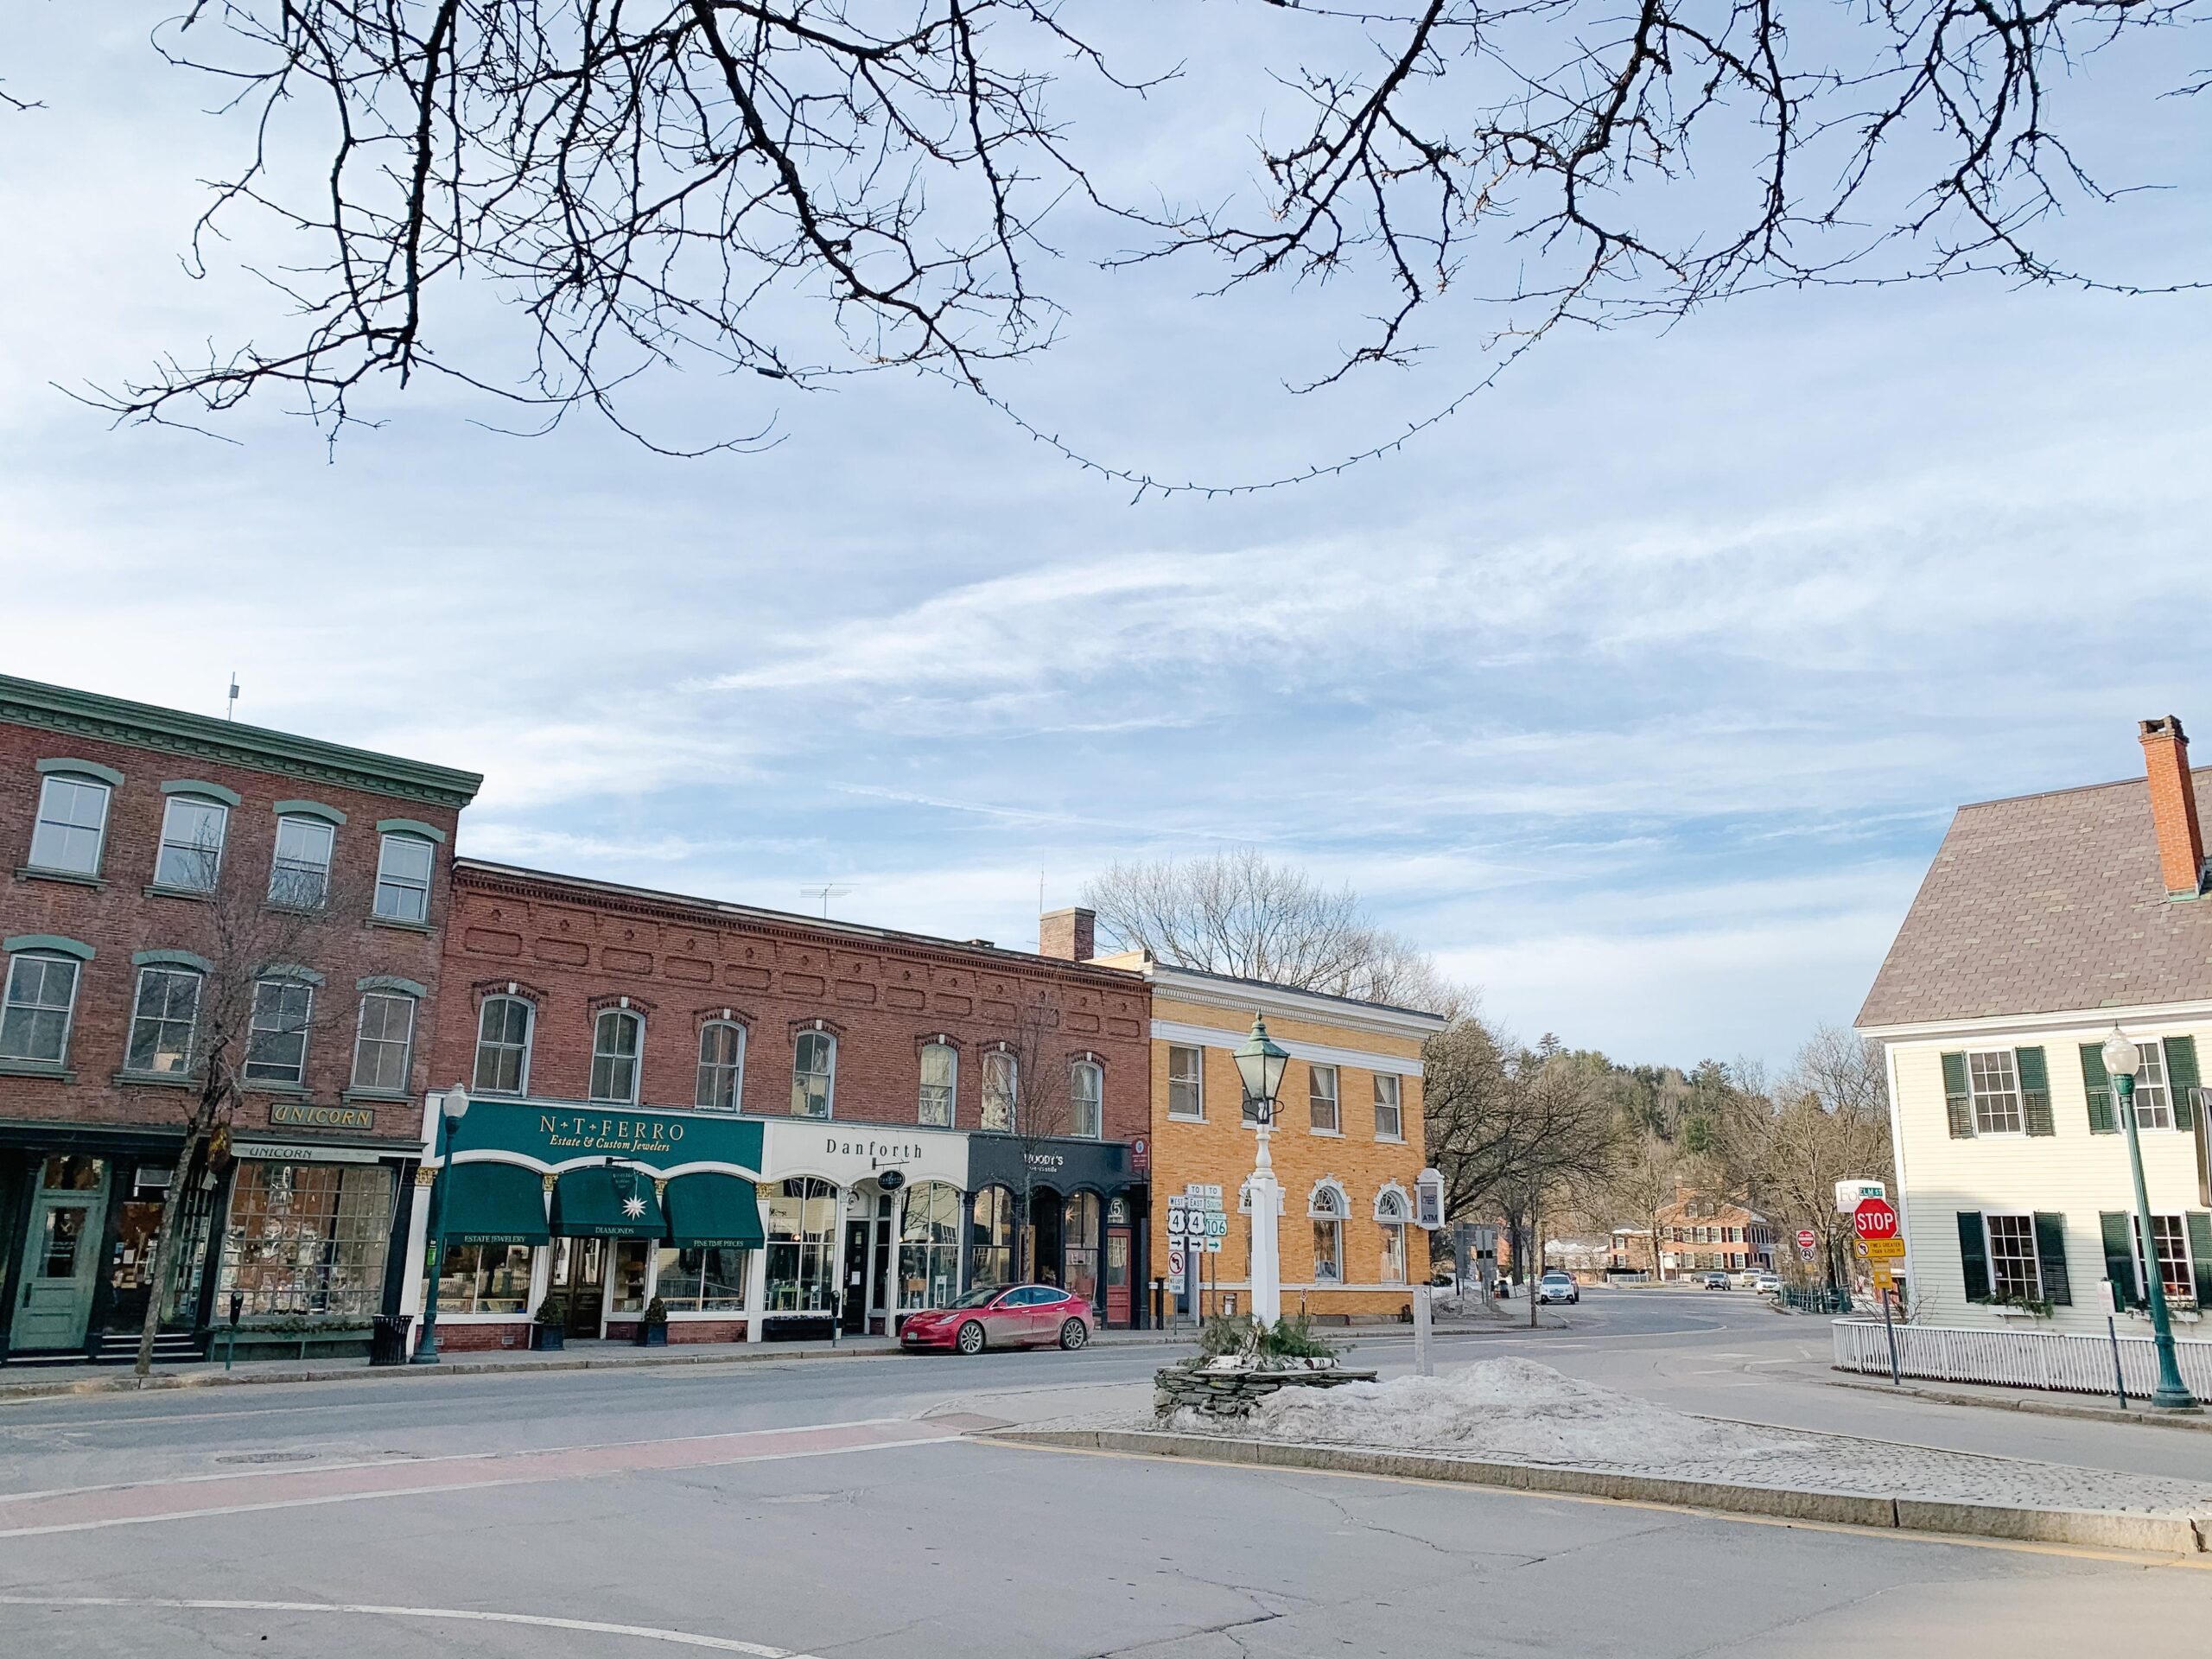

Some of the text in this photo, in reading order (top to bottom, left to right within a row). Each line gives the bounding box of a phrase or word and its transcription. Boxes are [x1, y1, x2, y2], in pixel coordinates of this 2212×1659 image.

[275, 1106, 370, 1126] UNICORN
[601, 1120, 684, 1141] FERRO
[550, 1135, 671, 1152] Estate & Custom Jewelers
[826, 1139, 922, 1159] Danforth
[250, 1147, 312, 1160] UNICORN
[1859, 1187, 1874, 1196] ELM
[1113, 1201, 1121, 1216] 5
[1173, 1215, 1179, 1228] 4
[1192, 1216, 1199, 1229] 4
[1207, 1220, 1226, 1234] 106
[1857, 1212, 1894, 1231] STOP
